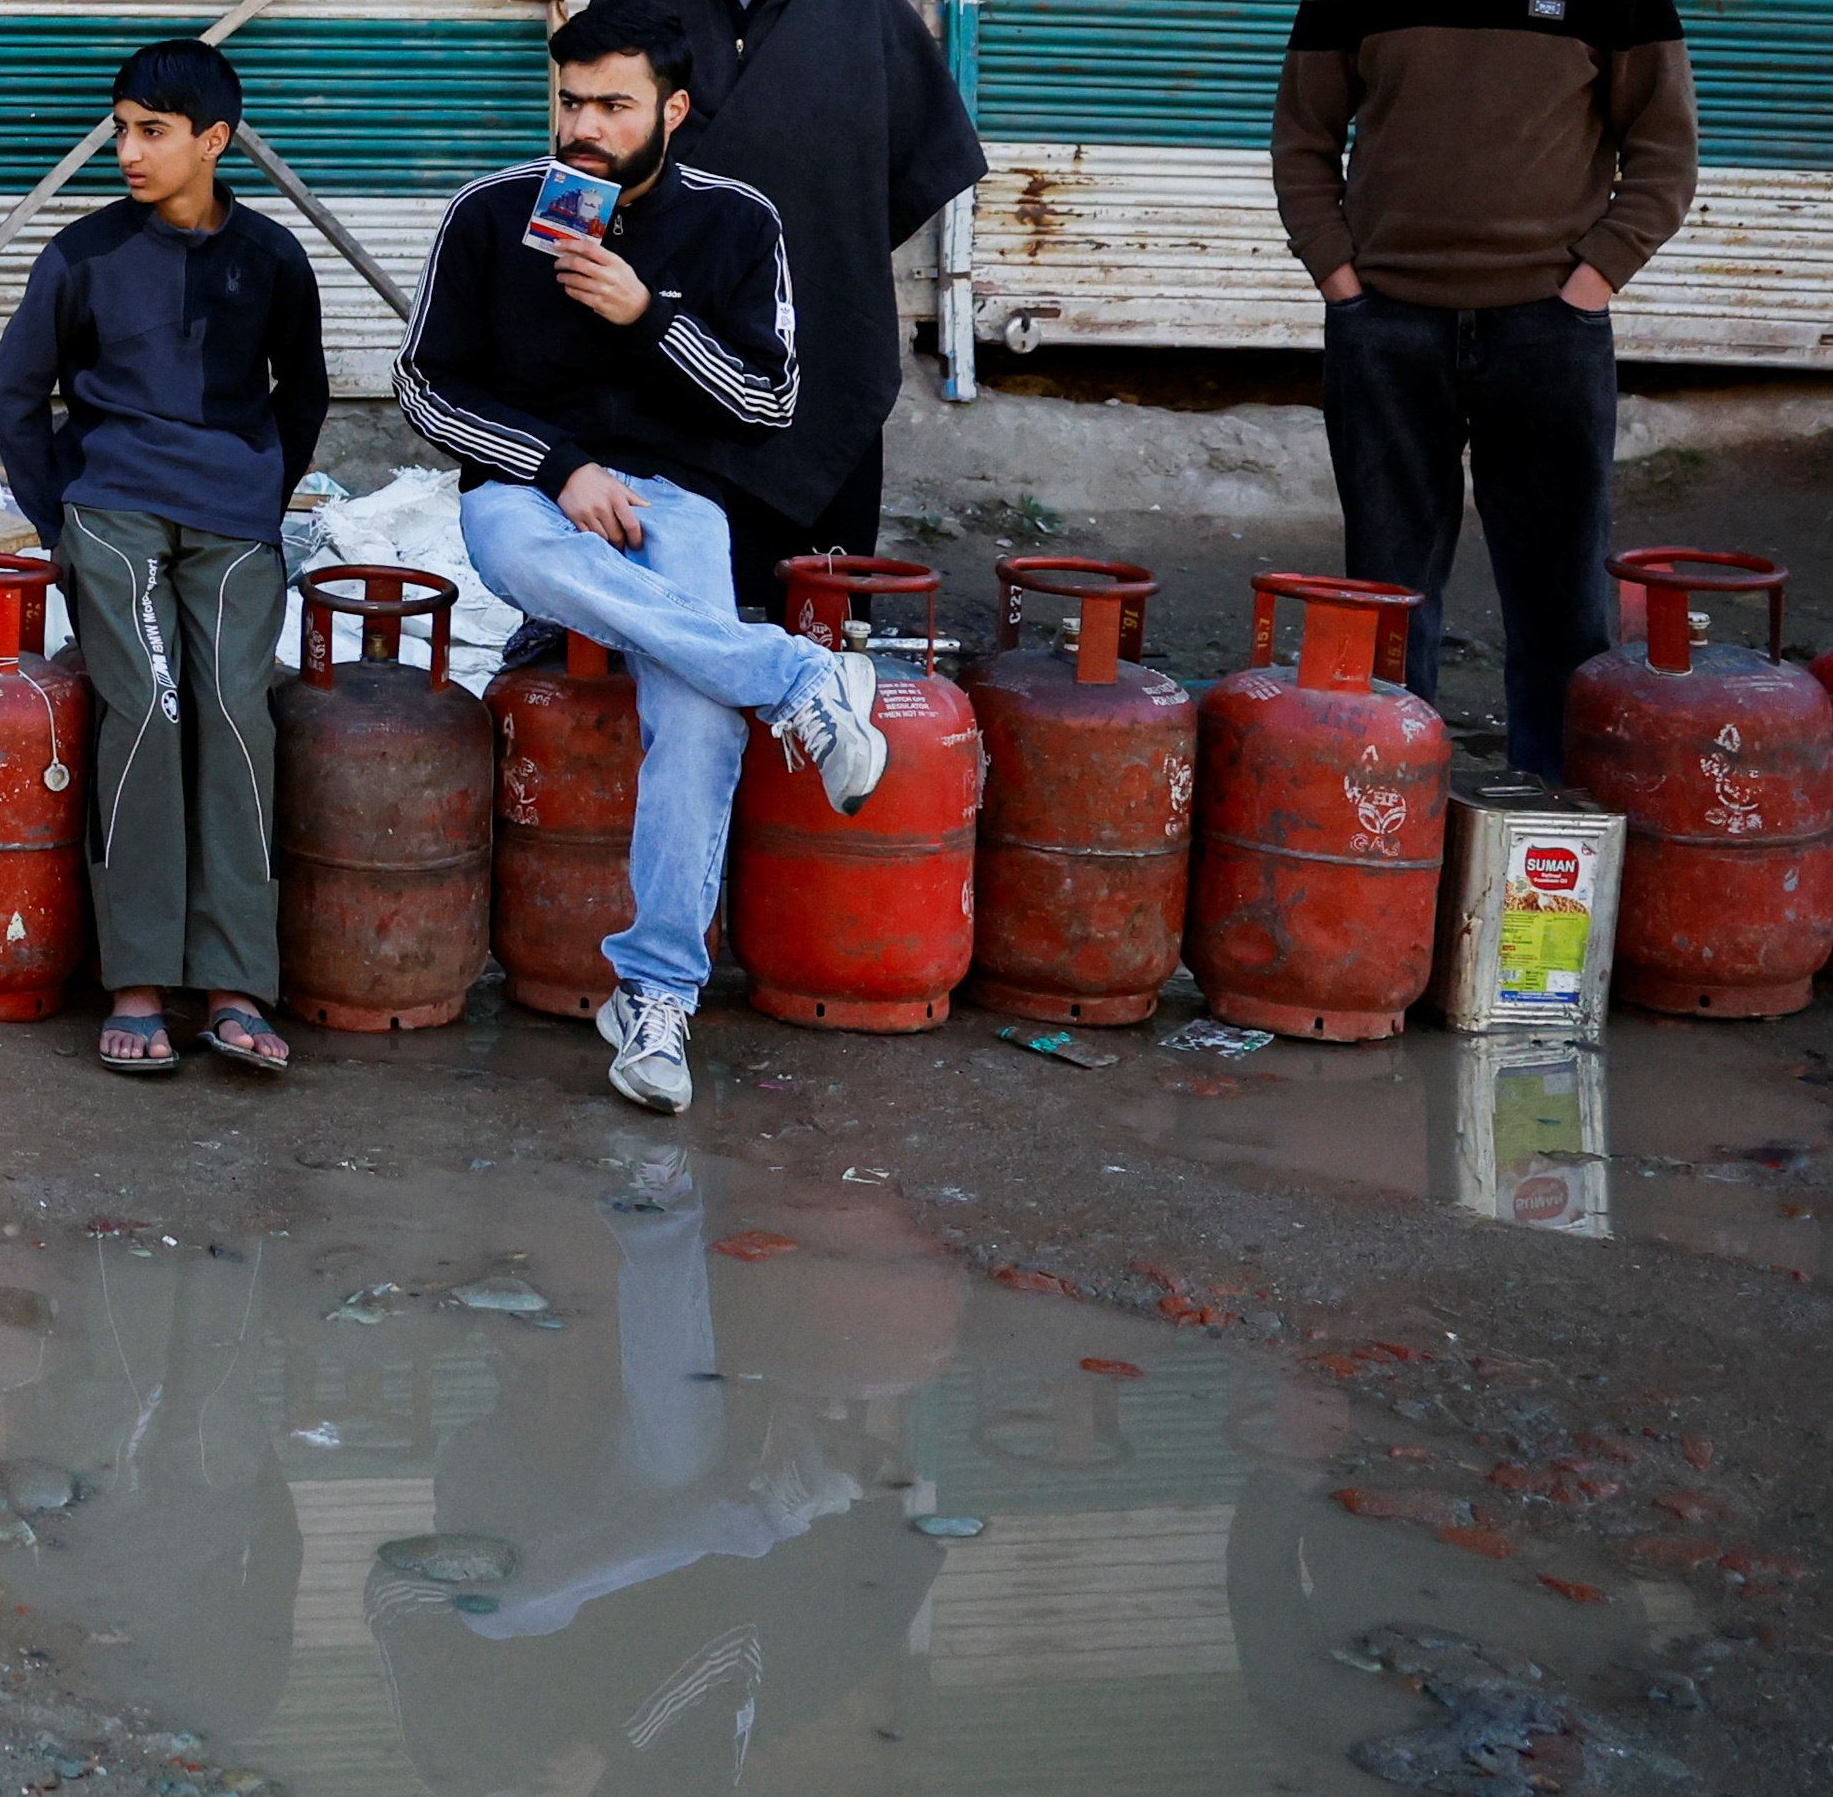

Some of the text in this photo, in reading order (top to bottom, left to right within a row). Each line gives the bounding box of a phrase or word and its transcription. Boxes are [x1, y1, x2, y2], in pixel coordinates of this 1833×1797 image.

[145, 624, 164, 653] BMW
[1257, 617, 1271, 650] 15.7
[1526, 858, 1575, 873] SUMAN
